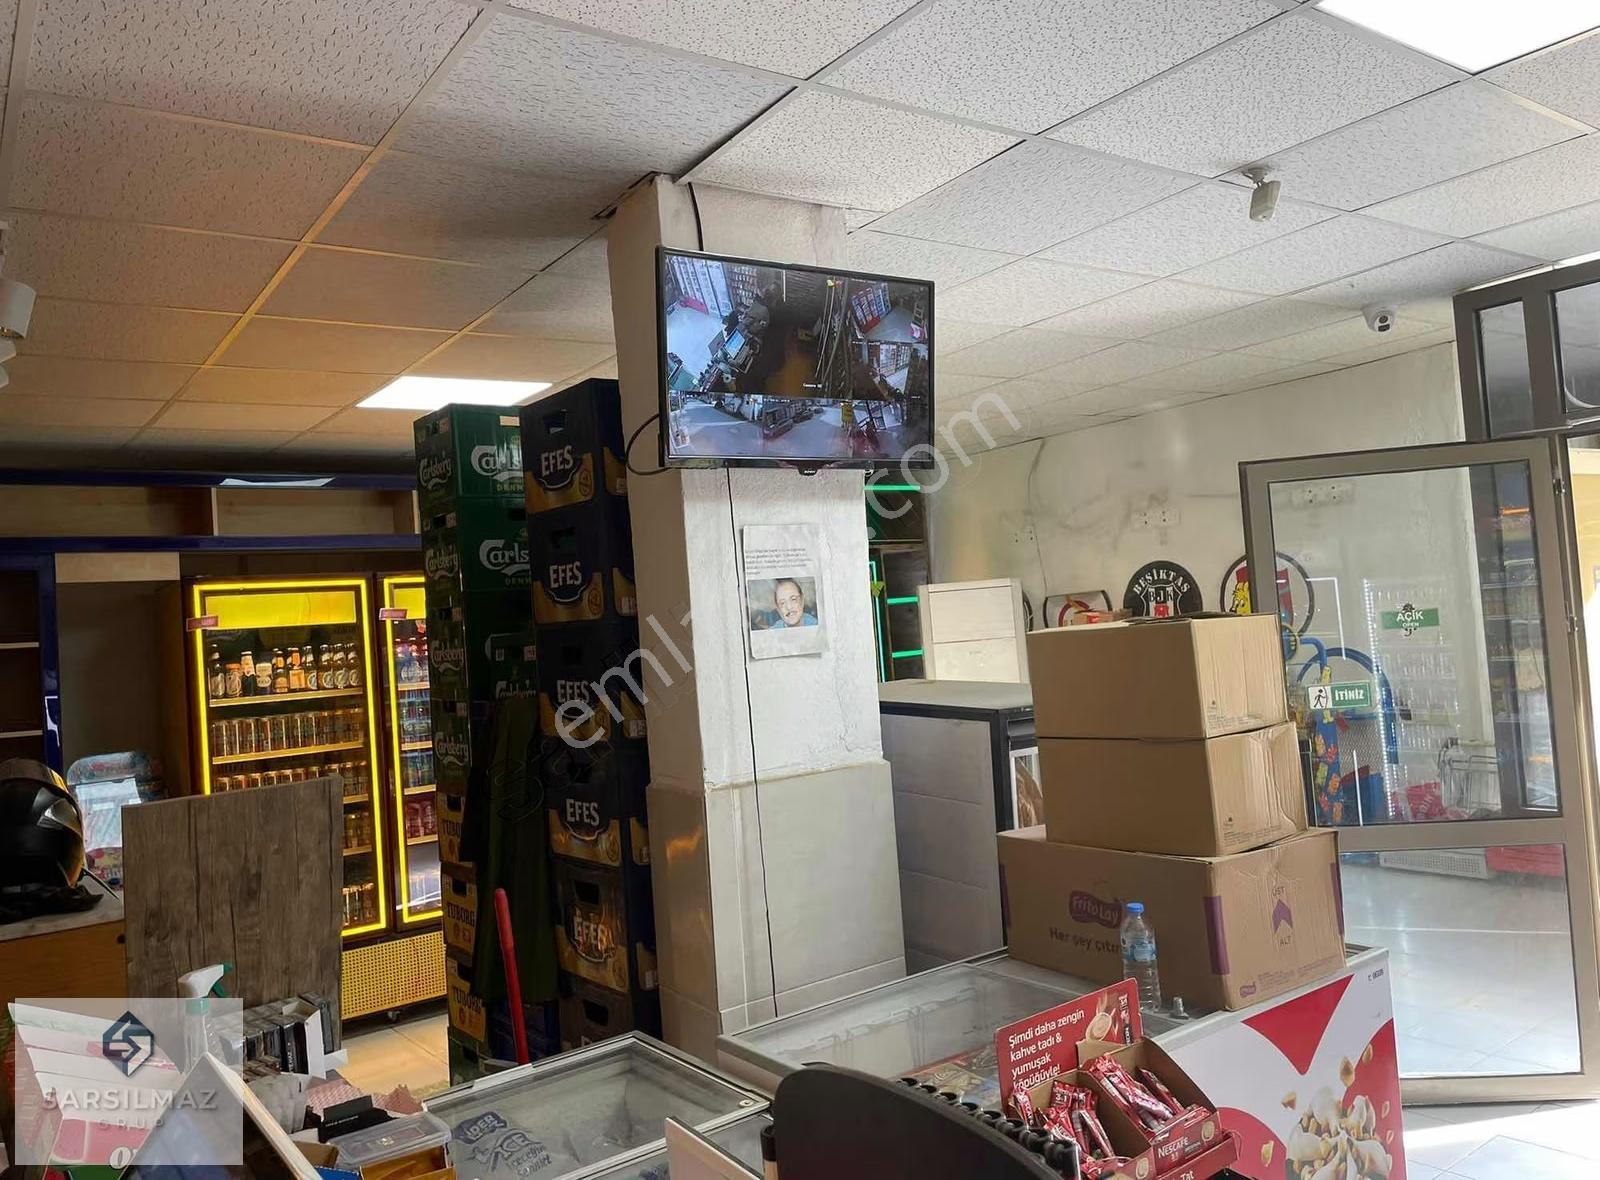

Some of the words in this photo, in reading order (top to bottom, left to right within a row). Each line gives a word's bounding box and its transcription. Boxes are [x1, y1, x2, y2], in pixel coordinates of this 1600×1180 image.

[420, 451, 452, 488] Carlsberg
[540, 446, 575, 477] EFES
[426, 544, 459, 580] Carlsberg
[549, 561, 583, 588] EFES
[557, 679, 591, 703] EFES
[435, 731, 468, 766] Carlsberg
[566, 798, 600, 827] EFES
[447, 902, 475, 928] TUBORG
[573, 914, 606, 945] EFES
[1280, 936, 1291, 945] ALT
[1008, 1027, 1034, 1049] Şimdi
[1034, 1020, 1057, 1037] daha
[1057, 1009, 1085, 1028] zengin
[1010, 1044, 1037, 1062] kahve
[1037, 1035, 1055, 1051] tadı
[1055, 1032, 1062, 1044] &
[1011, 1052, 1052, 1080] yumuşak
